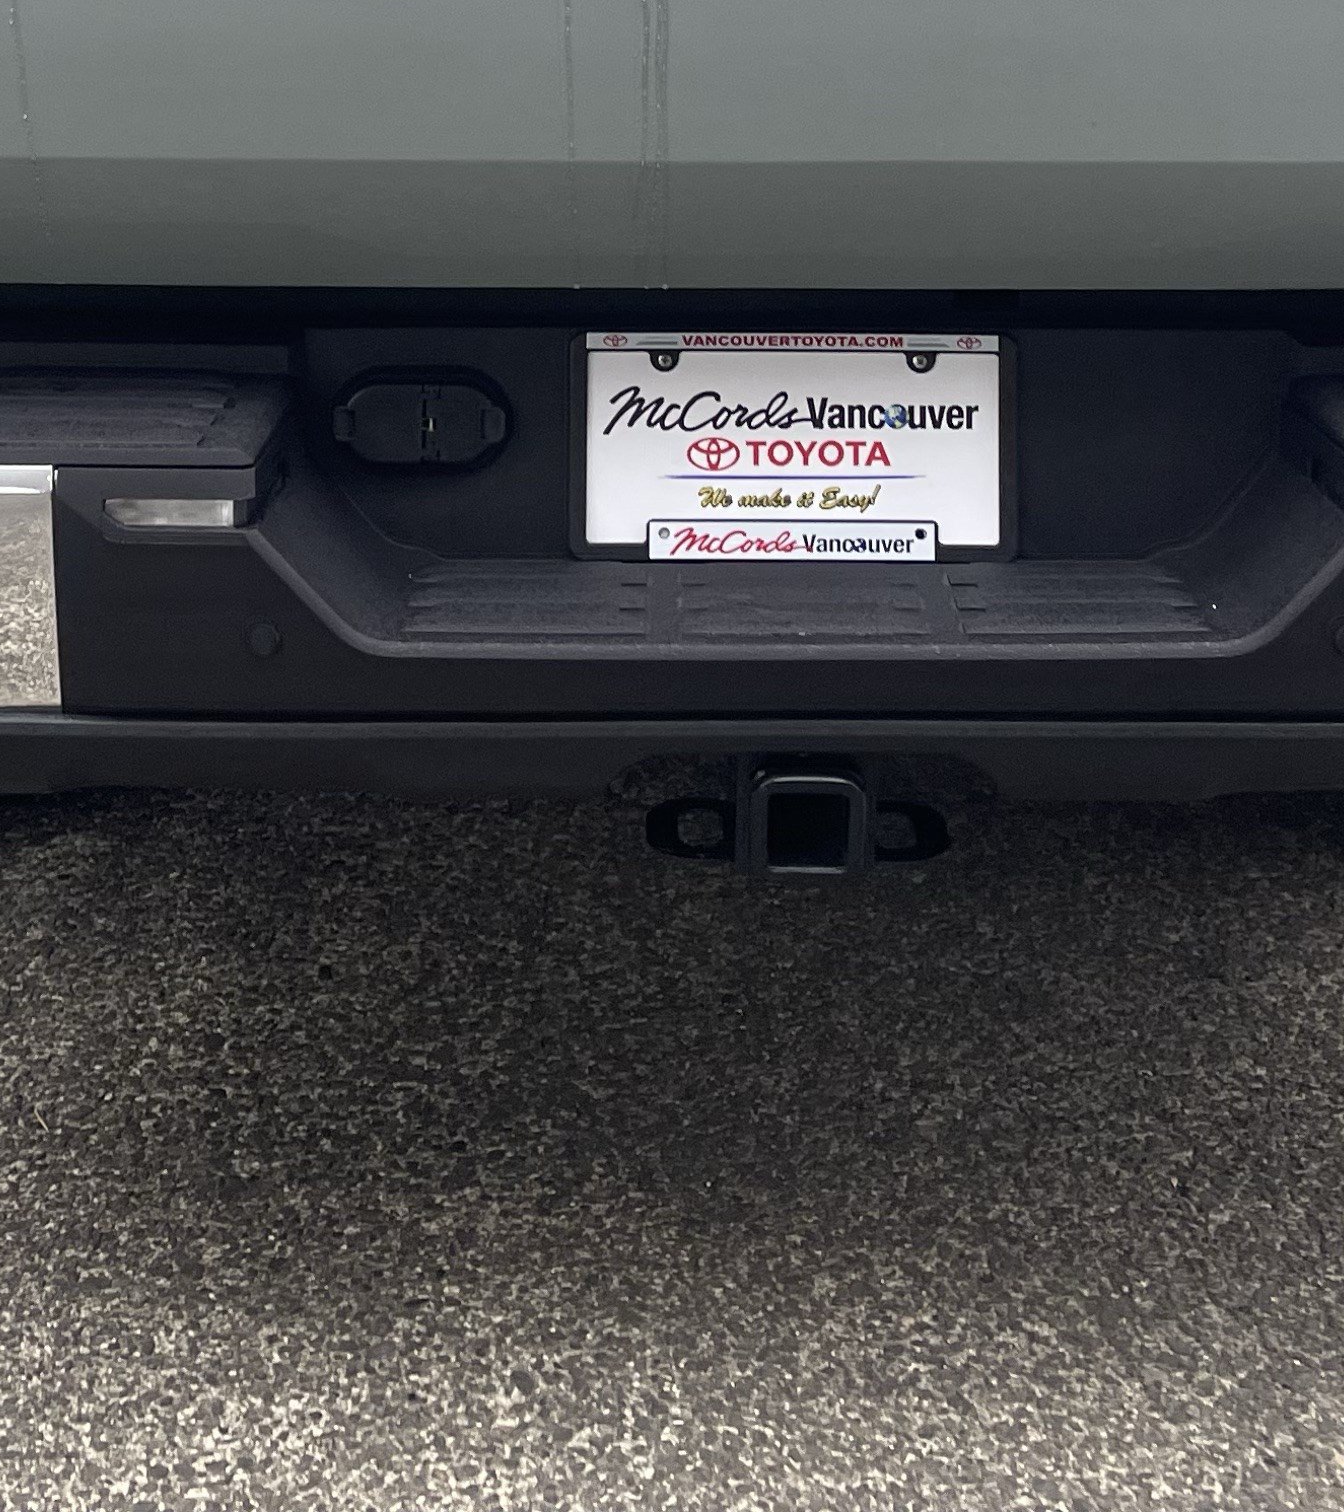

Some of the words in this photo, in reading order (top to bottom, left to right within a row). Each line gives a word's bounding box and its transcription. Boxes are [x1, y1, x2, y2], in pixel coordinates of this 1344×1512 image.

[681, 334, 904, 349] VANCOUVERTOYOTA.COM
[806, 397, 979, 430] Vancouver
[746, 439, 891, 467] TOYOTA
[698, 486, 733, 508] We
[738, 487, 792, 508] make
[797, 490, 814, 508] it
[819, 484, 882, 513] Easy!
